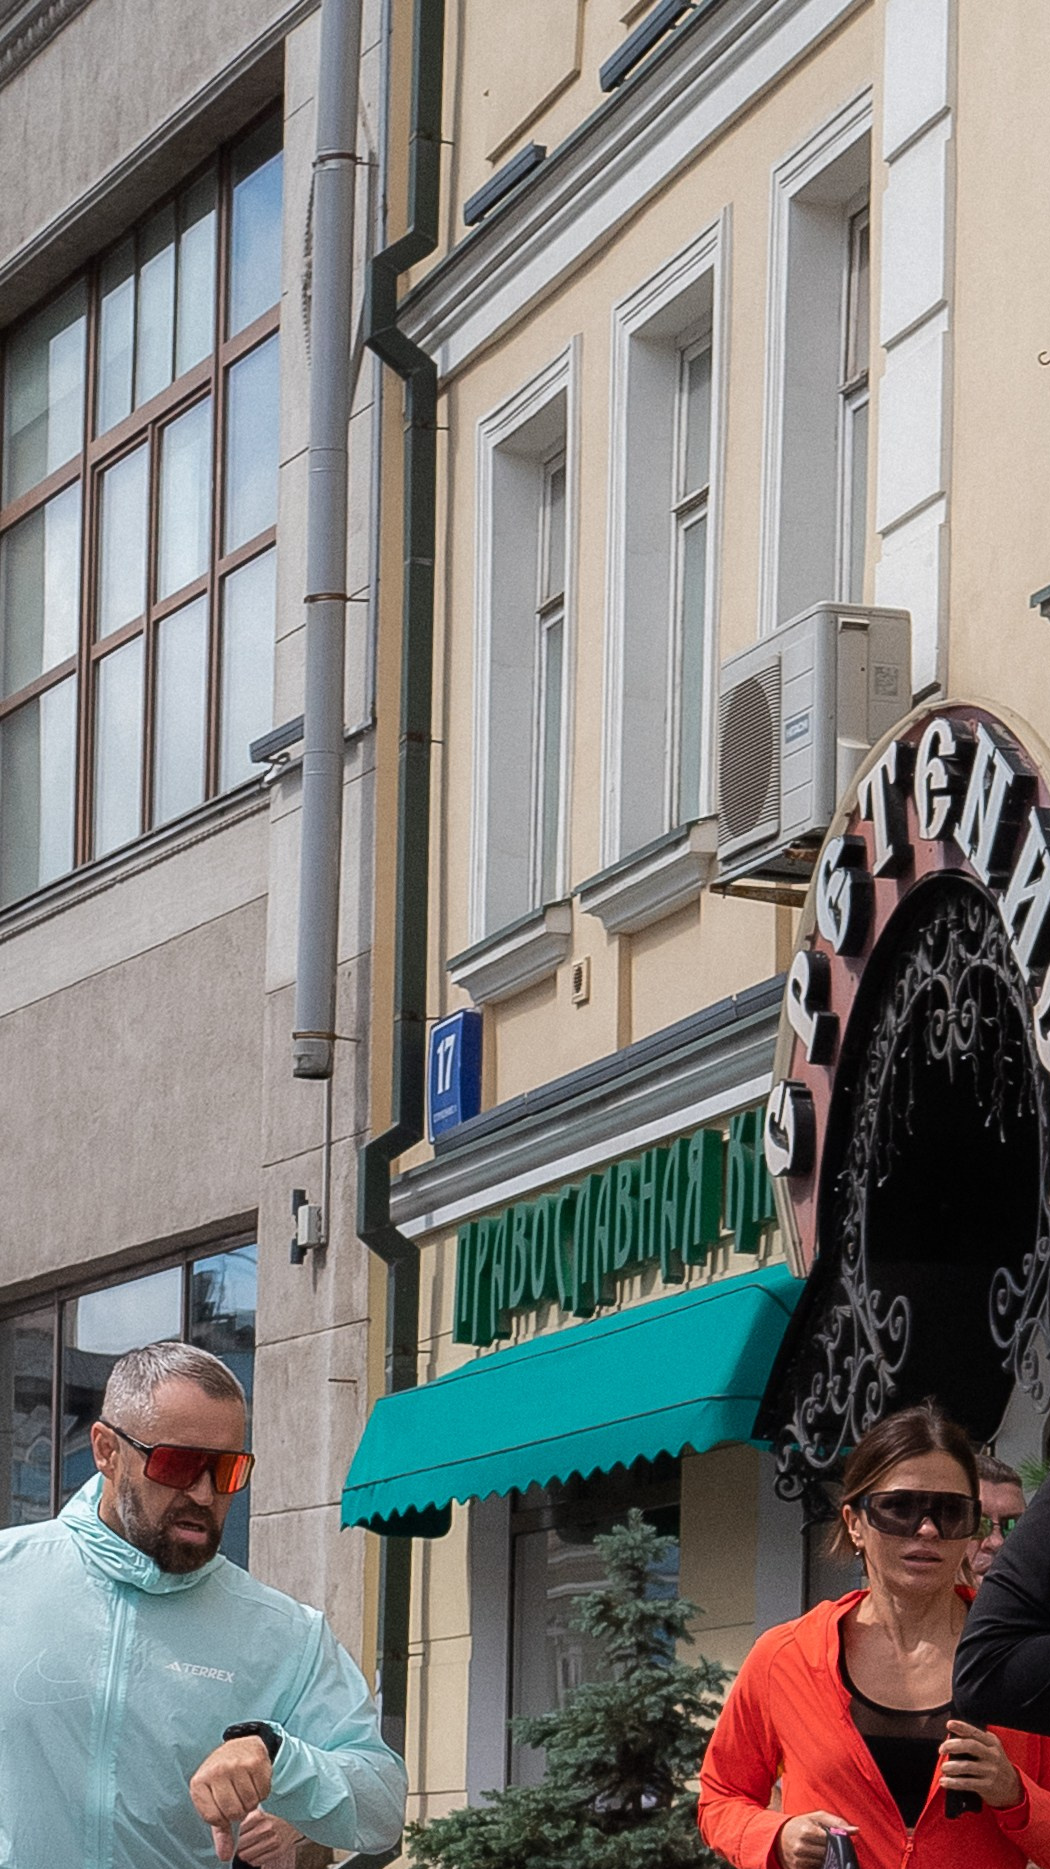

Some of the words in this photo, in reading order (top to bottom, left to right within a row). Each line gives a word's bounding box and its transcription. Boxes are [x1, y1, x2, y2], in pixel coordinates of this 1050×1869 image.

[437, 1034, 456, 1095] 17
[453, 1129, 721, 1346] ПРАВОСЛАВНАЯ
[182, 1662, 235, 1684] TERREX
